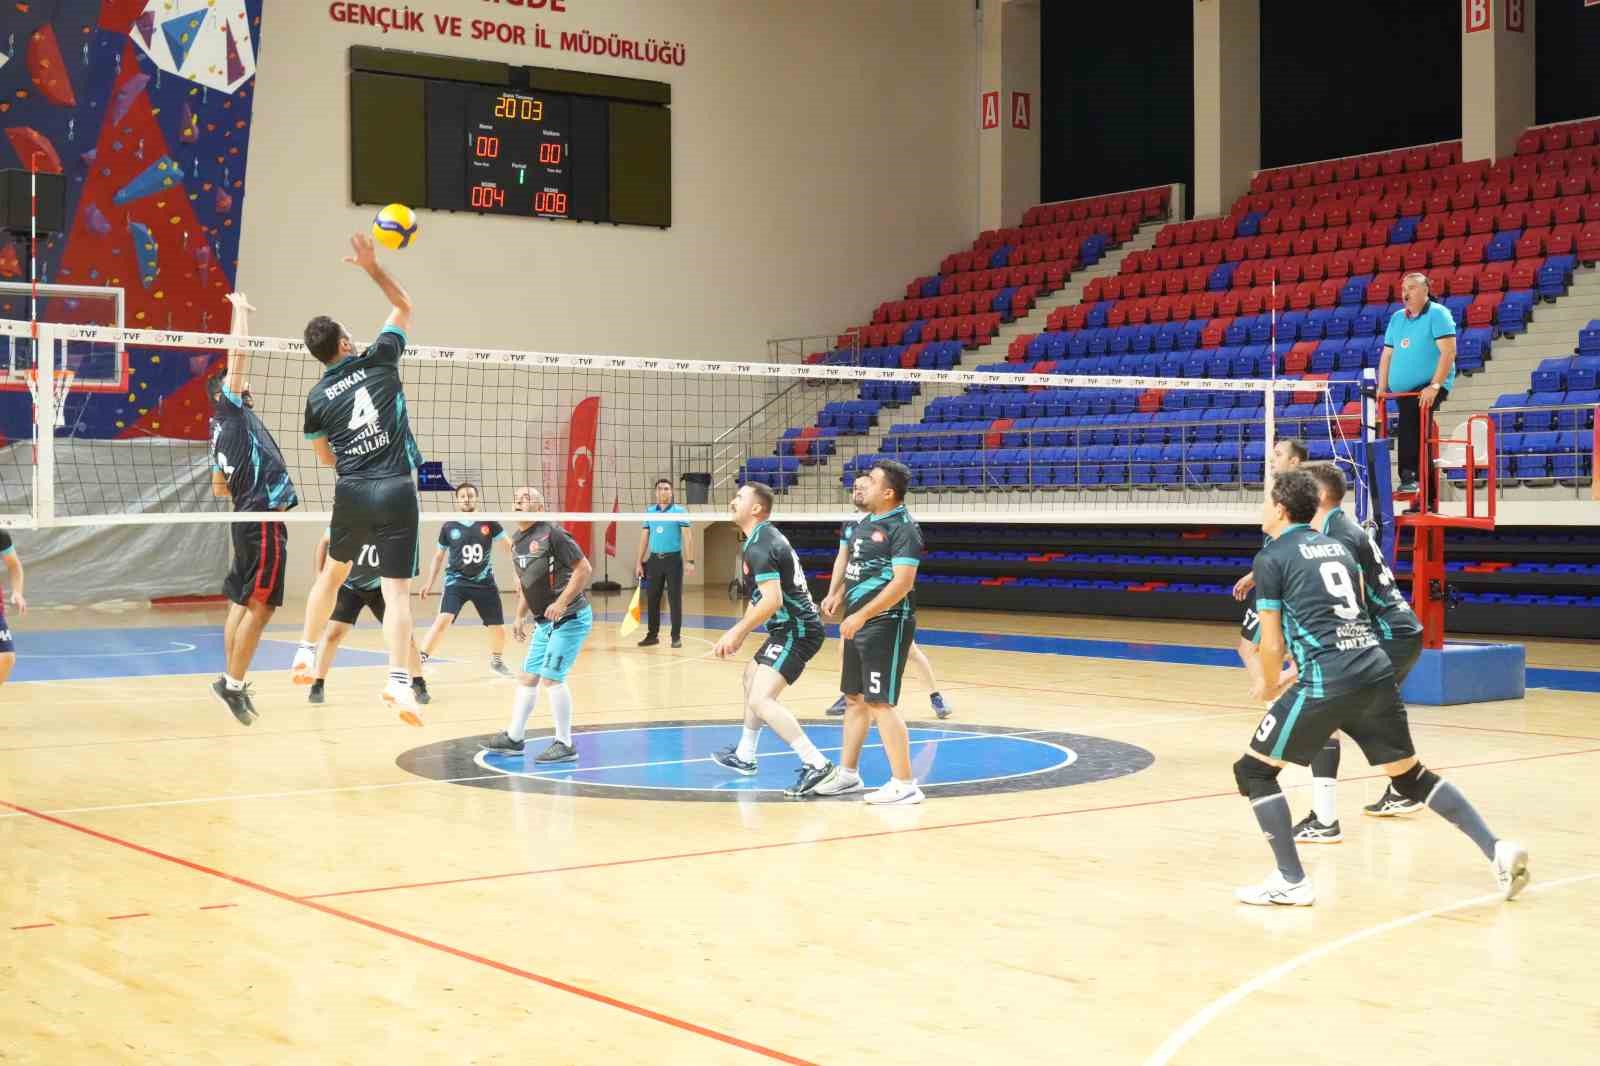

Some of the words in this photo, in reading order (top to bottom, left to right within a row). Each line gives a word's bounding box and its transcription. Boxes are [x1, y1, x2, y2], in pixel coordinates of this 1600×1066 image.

[1470, 0, 1486, 28] B
[329, 2, 424, 33] GENÇLİK
[433, 14, 462, 37] VE
[471, 19, 525, 45] SPOR
[535, 24, 551, 48] İL
[560, 30, 686, 66] MÜDÜRLÜĞÜ
[985, 95, 996, 126] A
[1015, 96, 1027, 126] A
[477, 136, 498, 158] 00
[540, 143, 561, 164] 00
[472, 186, 504, 208] 004
[535, 192, 566, 214] 008
[79, 329, 97, 338] TVF
[123, 332, 141, 342] TVF
[165, 334, 184, 343] TVF
[207, 336, 224, 346] TVF
[247, 339, 265, 349] TVF
[287, 341, 305, 351] TVF
[402, 348, 418, 357] TVF
[439, 350, 455, 358] TVF
[475, 352, 490, 360] TVF
[509, 353, 526, 362] TVF
[545, 356, 560, 364] TVF
[577, 357, 593, 366] TVF
[611, 359, 626, 367] TVF
[644, 360, 658, 369] TVF
[676, 362, 690, 370] TVF
[707, 363, 721, 372] TVF
[737, 365, 750, 373] TVF
[767, 366, 781, 374] TVF
[797, 367, 810, 375] TVF
[826, 368, 840, 376] TVF
[854, 369, 867, 377] TVF
[882, 370, 896, 378] TVF
[325, 368, 367, 400] BERKAY
[347, 386, 379, 431] 4
[462, 543, 484, 564] 99
[1298, 543, 1346, 560] ÖMER
[1319, 561, 1360, 620] 9
[868, 671, 881, 694] 5
[1255, 713, 1277, 742] 9
